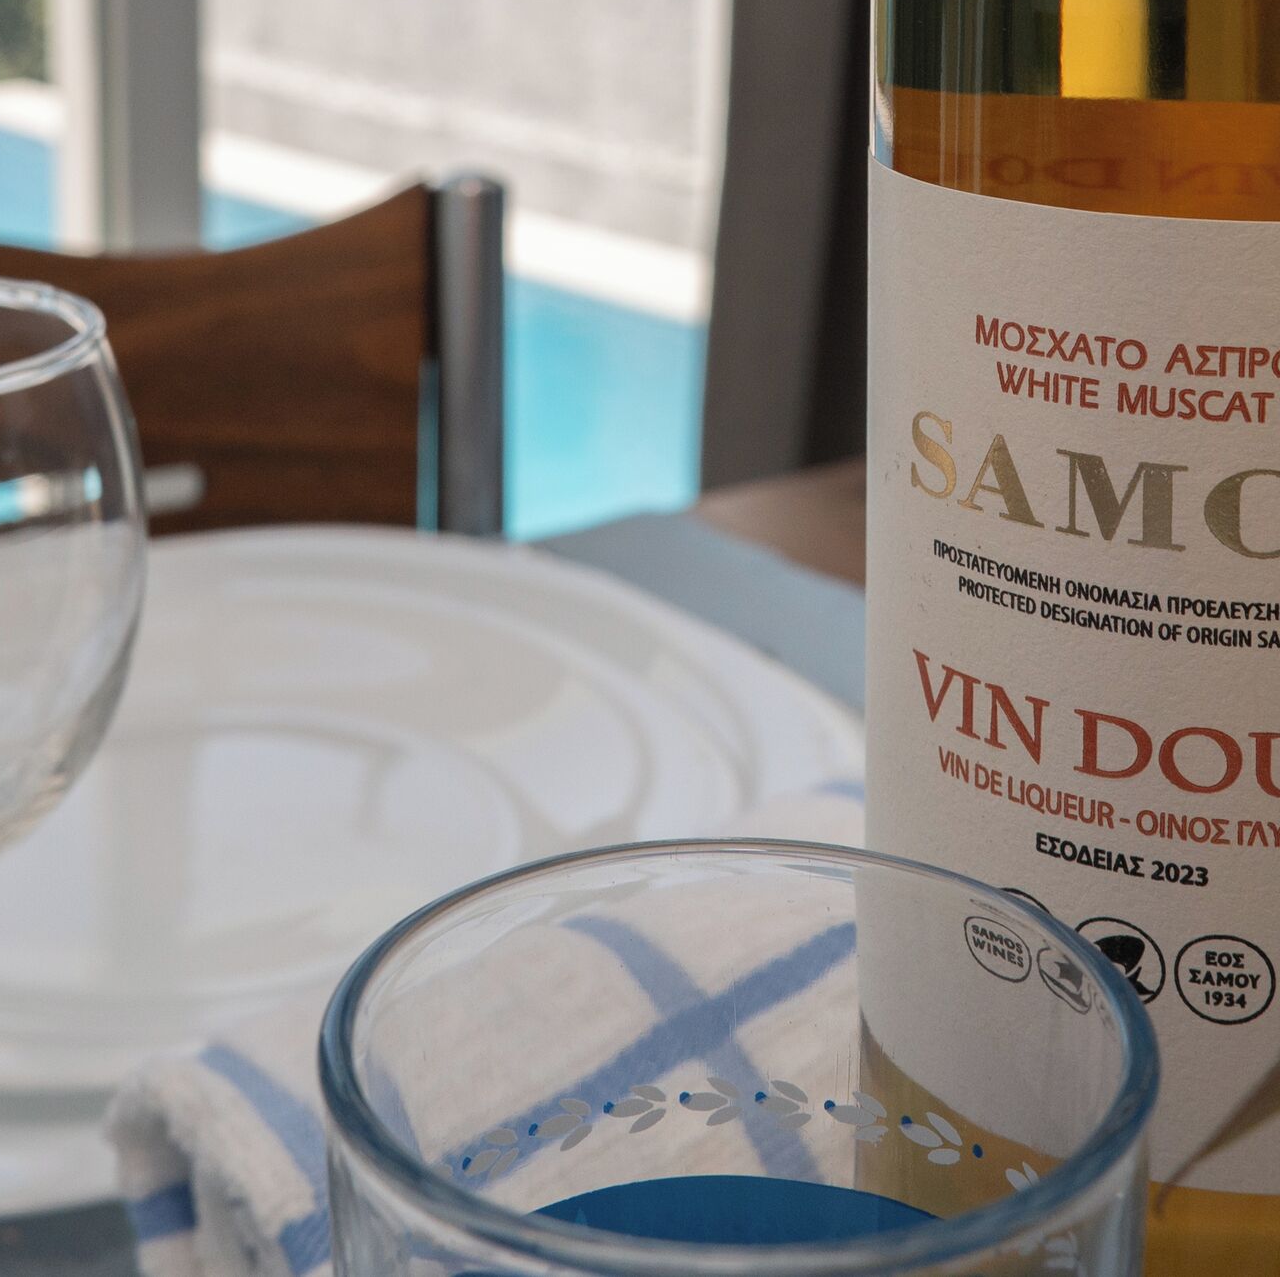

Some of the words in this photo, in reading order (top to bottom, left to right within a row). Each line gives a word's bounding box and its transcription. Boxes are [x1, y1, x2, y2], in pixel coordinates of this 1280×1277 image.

[974, 314, 1149, 371] ΜΟΣΧΑΤΟ
[996, 360, 1101, 410] WHITE
[1116, 383, 1275, 424] MUSCAT
[933, 538, 1061, 595] ΠΡΟΣΤΑΤΕΥΟΜΕΝΗ
[1064, 579, 1162, 613] ΟΝΟΜΑΣΙΑ
[958, 575, 1037, 615] PROTECTED
[1040, 602, 1153, 638] DESIGNATION
[1158, 623, 1182, 641] OF
[1186, 626, 1252, 647] ORIGIN
[912, 648, 1051, 765] VIN
[938, 745, 970, 784] VIN
[974, 761, 1003, 797] DE
[1007, 776, 1115, 830] LIQUEUR
[1136, 809, 1232, 846] ΟΙΝΟΣ
[1035, 831, 1146, 878] ΕΣΟΔΕΙΑΣ
[1150, 860, 1210, 888] 2023
[971, 924, 1023, 955] SAMOS
[972, 936, 1024, 969] WINES
[1204, 950, 1245, 969] ΕΟΣ
[1188, 968, 1261, 990] ΣΑΜΟΥ
[1204, 990, 1247, 1009] 1934
